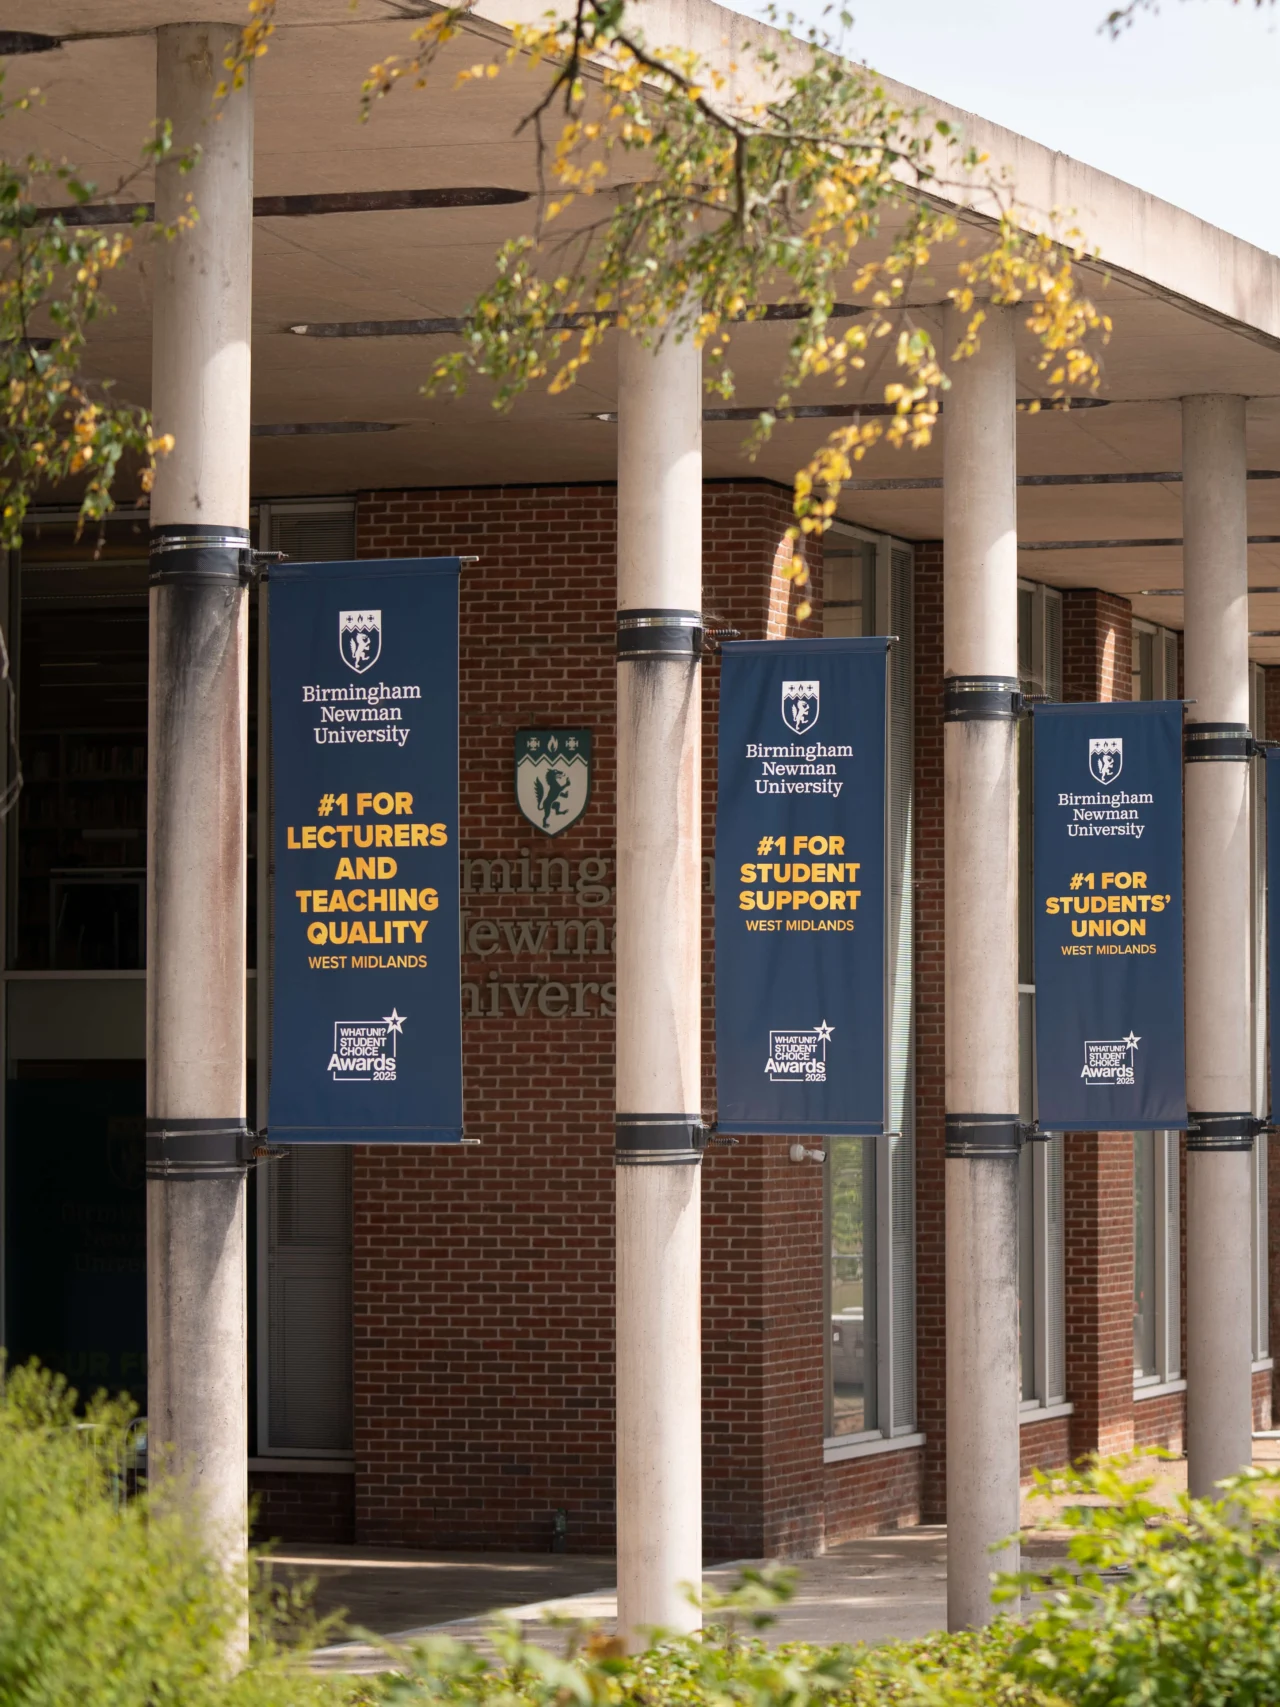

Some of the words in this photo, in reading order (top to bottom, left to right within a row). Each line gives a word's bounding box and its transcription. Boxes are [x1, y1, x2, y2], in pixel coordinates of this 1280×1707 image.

[303, 682, 421, 705] Birmingham
[321, 704, 402, 722] Newman
[314, 725, 410, 746] University
[746, 742, 853, 763] Birmingham
[762, 762, 836, 775] Newman
[755, 779, 843, 797] University
[318, 794, 348, 816] #1
[357, 792, 413, 815] FOR
[1058, 791, 1153, 808] Birmingham
[1073, 807, 1138, 820] Newman
[288, 823, 447, 849] LECTURERS
[1067, 823, 1145, 838] University
[757, 836, 786, 855] #1
[794, 836, 844, 855] FOR
[335, 857, 397, 880] AND
[740, 863, 860, 883] STUDENT
[1070, 873, 1094, 890] #1
[1102, 872, 1147, 889] FOR
[296, 888, 438, 912] TEACHING
[739, 890, 861, 910] SUPPORT
[307, 921, 428, 945] QUALITY
[746, 920, 782, 931] WEST
[786, 920, 854, 931] MIDLANDS
[1072, 919, 1146, 937] UNION
[1061, 946, 1093, 955] WEST
[1097, 944, 1156, 954] MIDLANDS
[309, 956, 347, 968] WEST
[352, 955, 427, 968] MIDLANDS
[340, 1037, 386, 1047] STUDENT
[775, 1044, 817, 1053] STUDENT
[340, 1047, 378, 1056] CHOICE
[775, 1052, 810, 1061] CHOICE
[328, 1054, 396, 1071] Awards
[765, 1059, 825, 1073] Awards
[1081, 1065, 1134, 1077] Awards
[373, 1071, 396, 1080] 2025
[805, 1073, 826, 1081] 2025
[1116, 1077, 1134, 1085] 2025
